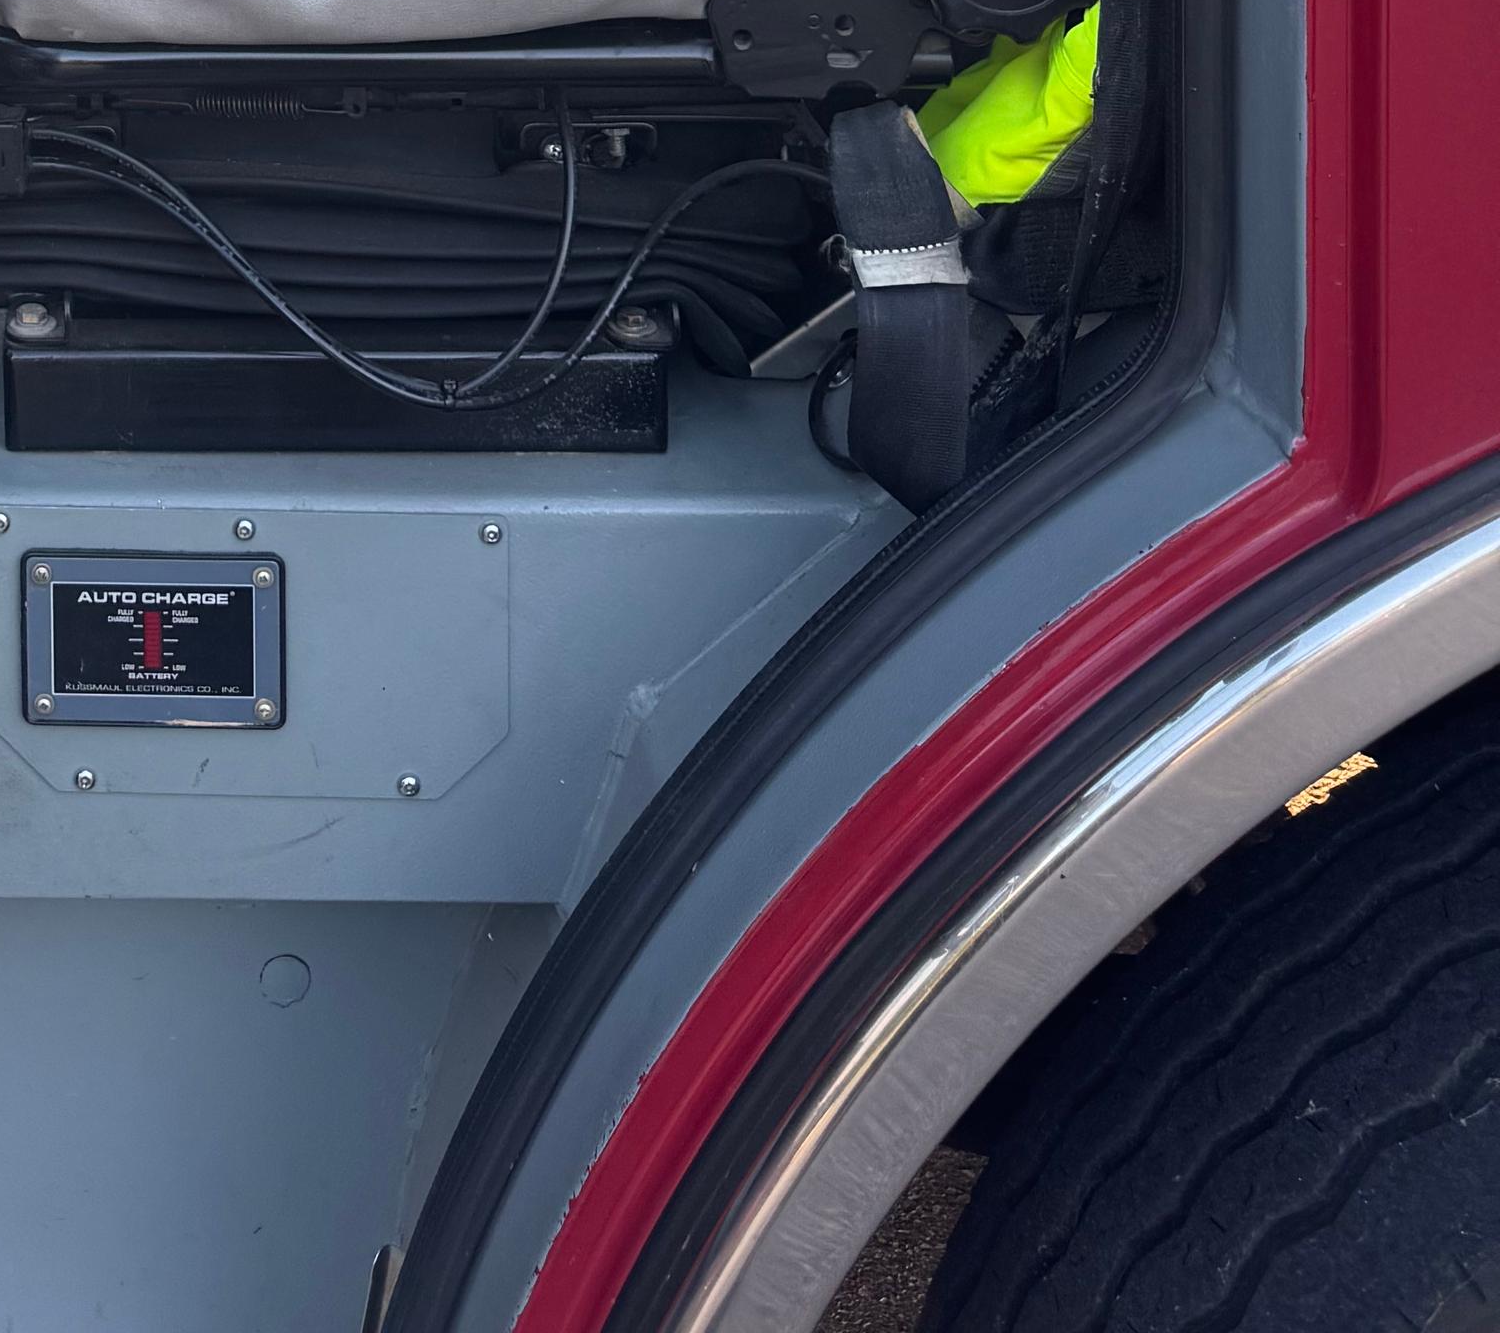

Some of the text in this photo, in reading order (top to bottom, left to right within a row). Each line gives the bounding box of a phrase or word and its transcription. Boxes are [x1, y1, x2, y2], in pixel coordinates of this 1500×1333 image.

[77, 591, 137, 604] AUTO
[107, 615, 135, 623] CHARGED
[172, 616, 199, 624] CHARGED
[128, 672, 179, 680] BATTERY
[65, 683, 122, 692] KUSSMAUL
[125, 684, 194, 693] ELECTRONICS
[221, 685, 242, 694] INC.
